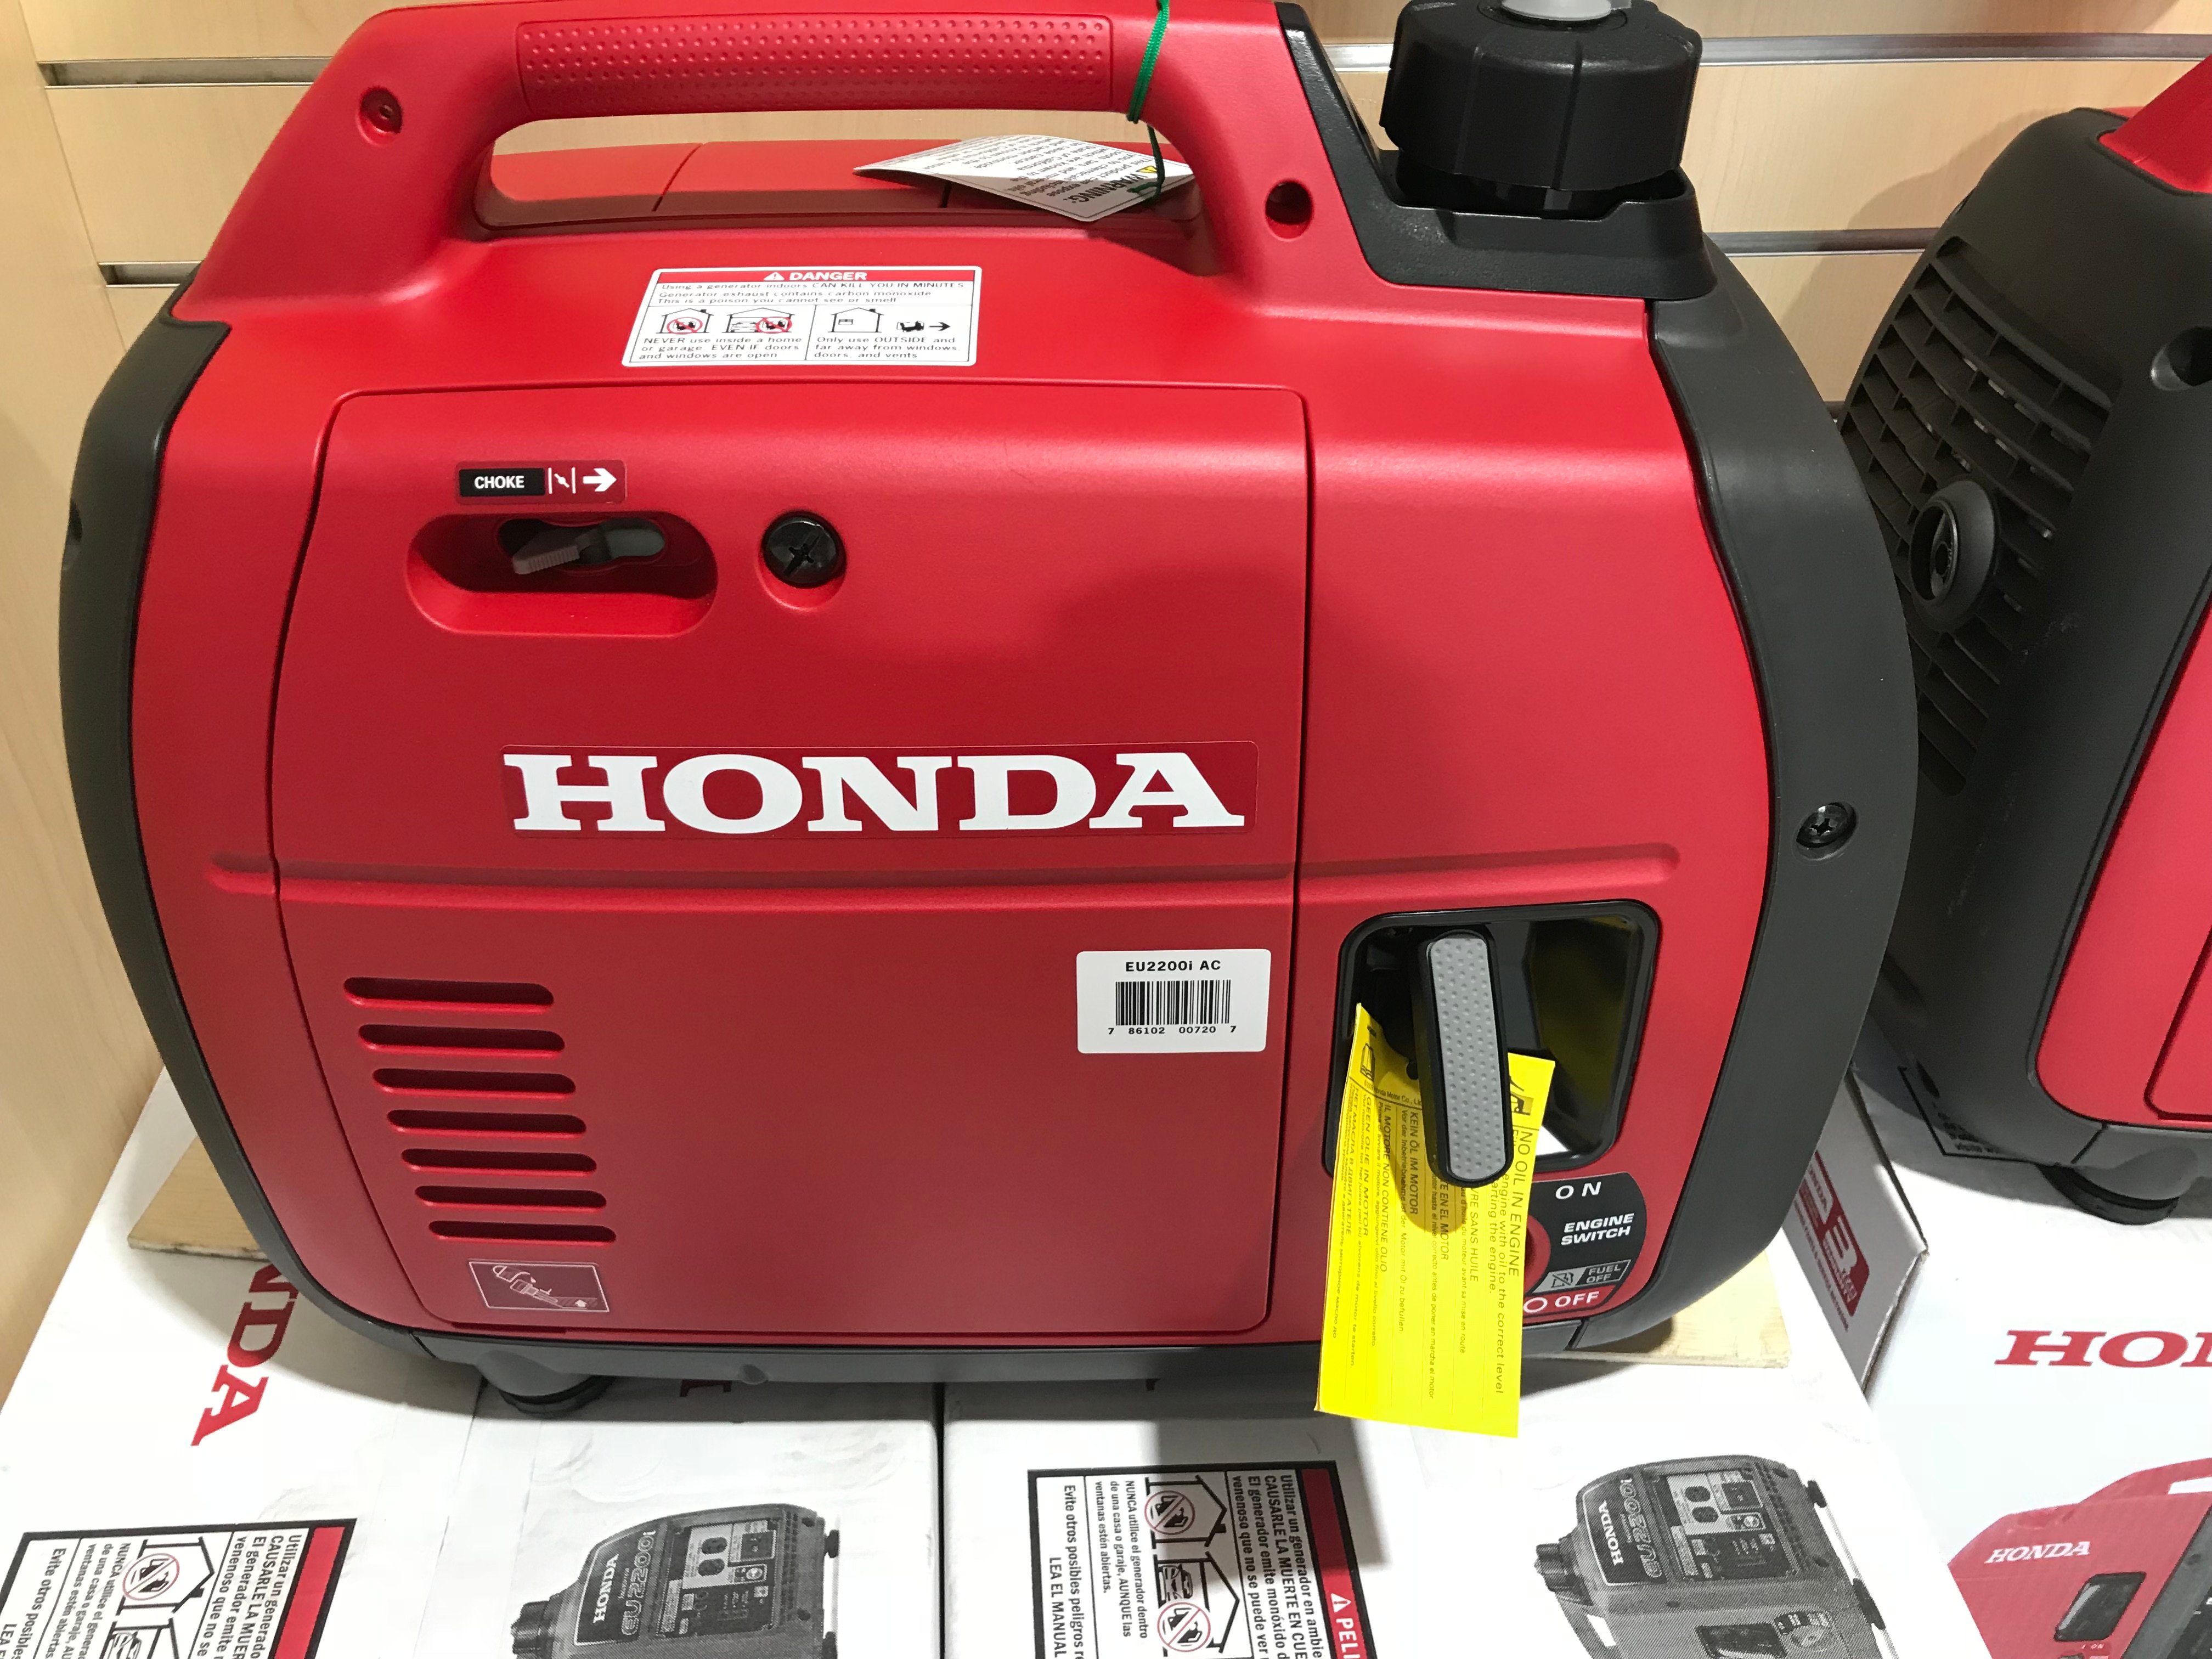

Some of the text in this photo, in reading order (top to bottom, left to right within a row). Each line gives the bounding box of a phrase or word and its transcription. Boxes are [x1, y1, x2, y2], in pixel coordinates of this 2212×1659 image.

[1097, 164, 1132, 178] product
[1047, 183, 1081, 197] expose
[1063, 174, 1148, 204] WARNING:
[789, 272, 868, 281] DANGER
[474, 475, 525, 490] CHOKE
[503, 751, 1245, 834] HONDA
[1125, 960, 1221, 972] EU2200i AC
[1108, 1027, 1115, 1035] 7
[1229, 1025, 1237, 1034] 7
[1518, 1131, 1533, 1155] NO
[1348, 1158, 1355, 1166] В
[1409, 1111, 1419, 1215] KEIN IM MOTOR
[1514, 1160, 1528, 1186] OIL
[1380, 1115, 1392, 1244] MOTORE NON CONTIENE
[1511, 1192, 1524, 1208] IN
[1560, 1226, 1632, 1246] SWITCH
[1564, 1212, 1635, 1233] ENGINE
[1470, 1211, 1479, 1282] SANS HUILE
[1487, 1223, 1498, 1294] the engine.
[1509, 1213, 1522, 1277] ENGINE
[1496, 1174, 1510, 1394] engine with oil to the correct level
[1585, 1273, 1611, 1284] OFF
[1588, 1263, 1622, 1276] FUEL
[1554, 1290, 1600, 1308] OFF
[1110, 1481, 1121, 1492] de
[1248, 1476, 1262, 1486] El
[1064, 1485, 1076, 1511] Evite
[1095, 1481, 1108, 1522] ventanas
[1111, 1494, 1121, 1511] una
[1264, 1475, 1286, 1536] CAUSARLE
[1066, 1514, 1079, 1543] otros
[1113, 1512, 1124, 1534] casa
[1247, 1489, 1271, 1548] generador
[1598, 1499, 1624, 1566] HONDA
[252, 1536, 267, 1547] El
[1275, 1539, 1290, 1555] LA
[1280, 1474, 1315, 1615] Utilizar un generador en
[1984, 1541, 2091, 1564] HONDA
[44, 1548, 67, 1577] Evite
[219, 1536, 247, 1593] venenoso
[270, 1534, 302, 1597] Utilizar un
[1065, 1545, 1082, 1595] posibles
[1125, 1480, 1149, 1639] NUNCA utilice el generador dentro
[1232, 1476, 1269, 1654] venenoso que no se puede ver
[1260, 1550, 1279, 1585] emite
[229, 1551, 259, 1613] generador
[245, 1536, 284, 1620] CAUSARLE LA
[592, 1554, 619, 1623] HONDA
[1278, 1557, 1300, 1609] MUERTE
[210, 1596, 226, 1620] que
[1049, 1557, 1068, 1658] LEA EL MANUAL
[1118, 1578, 1132, 1620] AUNQUE
[203, 1623, 217, 1639] no
[1068, 1598, 1085, 1648] peligros
[1121, 1622, 1132, 1638] las
[1266, 1588, 1288, 1649] monóxido
[1288, 1612, 1303, 1629] EN
[216, 1616, 238, 1652] emite
[1335, 1617, 1361, 1659] PELI
[196, 1641, 211, 1657] se
